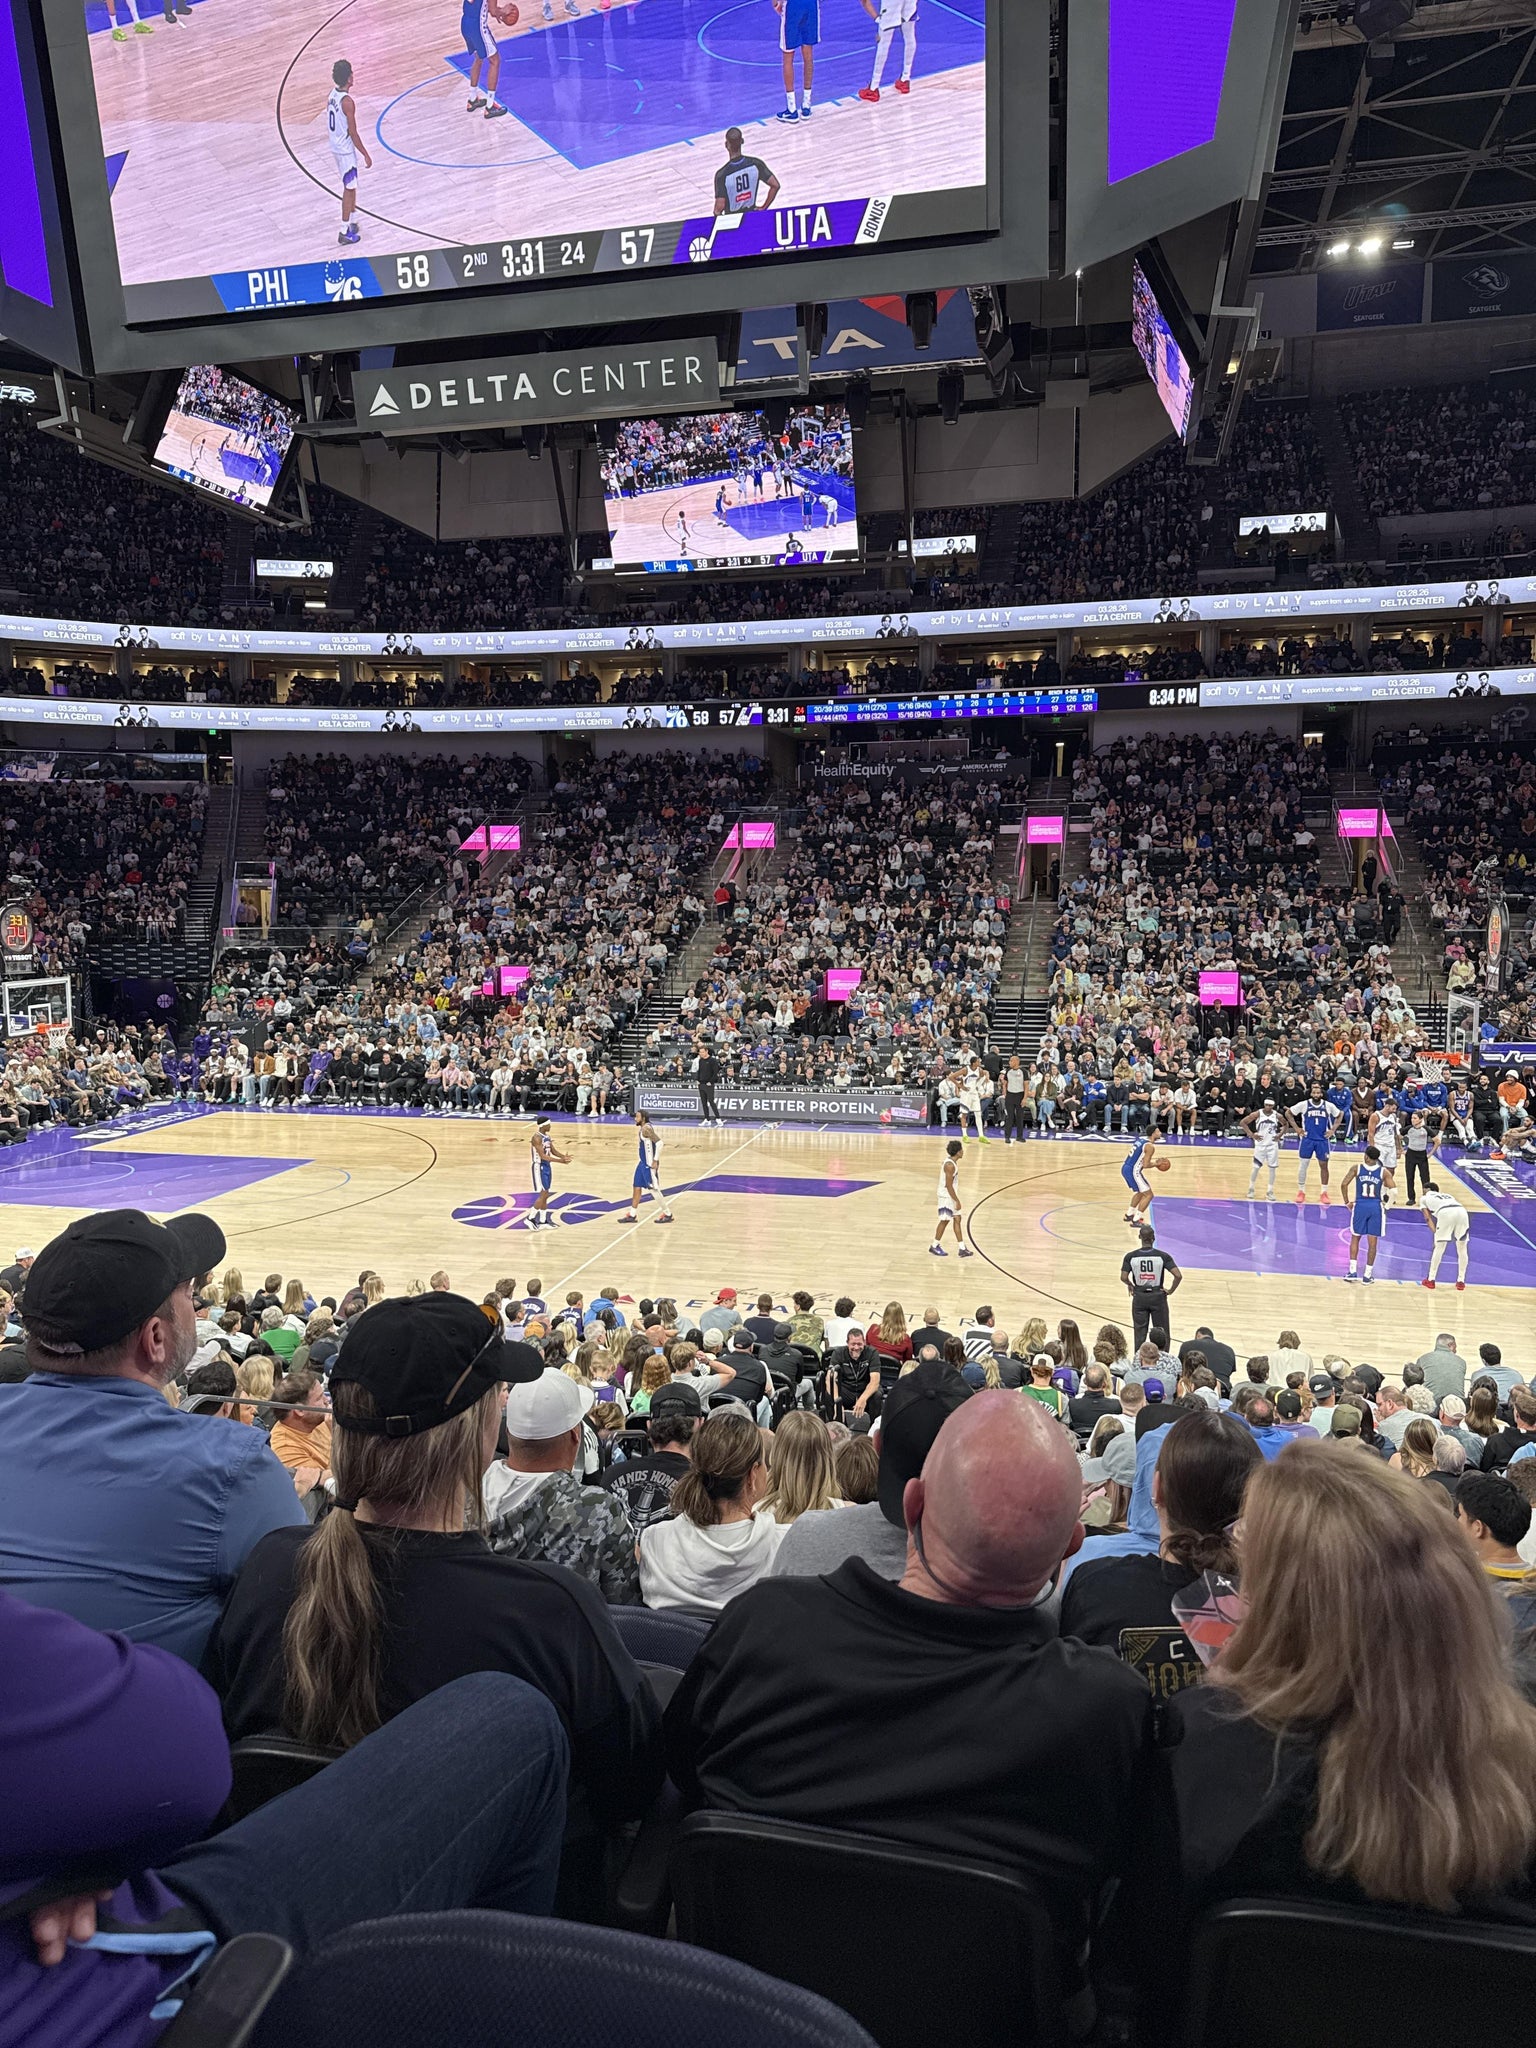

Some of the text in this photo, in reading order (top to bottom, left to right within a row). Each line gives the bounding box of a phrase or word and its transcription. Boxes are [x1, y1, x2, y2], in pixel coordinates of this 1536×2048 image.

[329, 110, 336, 132] 0
[736, 173, 750, 193] 60
[862, 199, 887, 239] BONUS
[775, 206, 832, 246] UTA
[620, 229, 654, 265] 57
[463, 240, 585, 279] 2ND 3:31 24
[396, 254, 430, 290] 58
[247, 268, 363, 304] PHI 76
[408, 356, 703, 411] DELTA CENTER
[653, 561, 667, 571] PHI
[697, 559, 708, 568] 58
[760, 555, 771, 565] 57
[801, 551, 818, 562] UTA
[1396, 589, 1429, 597] 03.28.26
[1235, 599, 1248, 610] by
[1380, 595, 1445, 607] DELTA CENTER
[1098, 605, 1128, 613] 03.28.26
[951, 615, 962, 625] by
[1083, 612, 1142, 623] DELTA CENTER
[43, 630, 102, 642] DELTA CENTER
[191, 633, 202, 643] by
[692, 629, 702, 639] by
[812, 628, 865, 638] DELTA CENTER
[319, 643, 342, 651] DELTA
[343, 644, 371, 652] CENTER
[451, 637, 462, 646] by
[565, 640, 588, 648] DELTA
[589, 639, 615, 647] CENTER
[1387, 679, 1420, 687] 03.28.26
[1149, 687, 1197, 705] 8:34 PM
[1228, 686, 1240, 697] by
[1371, 686, 1436, 696] DELTA CENTER
[191, 711, 202, 721] by
[767, 707, 789, 723] 3:31
[795, 706, 805, 714] 24
[43, 712, 103, 722] DELTA CENTER
[451, 715, 461, 724] by
[564, 719, 586, 727] DELTA
[587, 718, 613, 726] CENTER
[666, 710, 689, 728] 76
[693, 710, 709, 725] 58
[719, 709, 735, 724] 57
[318, 720, 371, 728] DELTA CENTER
[814, 763, 895, 778] HealthEquity
[7, 926, 27, 946] 24
[643, 1100, 696, 1109] INGREDIENTS
[752, 1099, 806, 1112] BETTER
[810, 1101, 878, 1114] PROTEIN.
[1362, 1184, 1375, 1197] 11
[1140, 1260, 1154, 1273] 60
